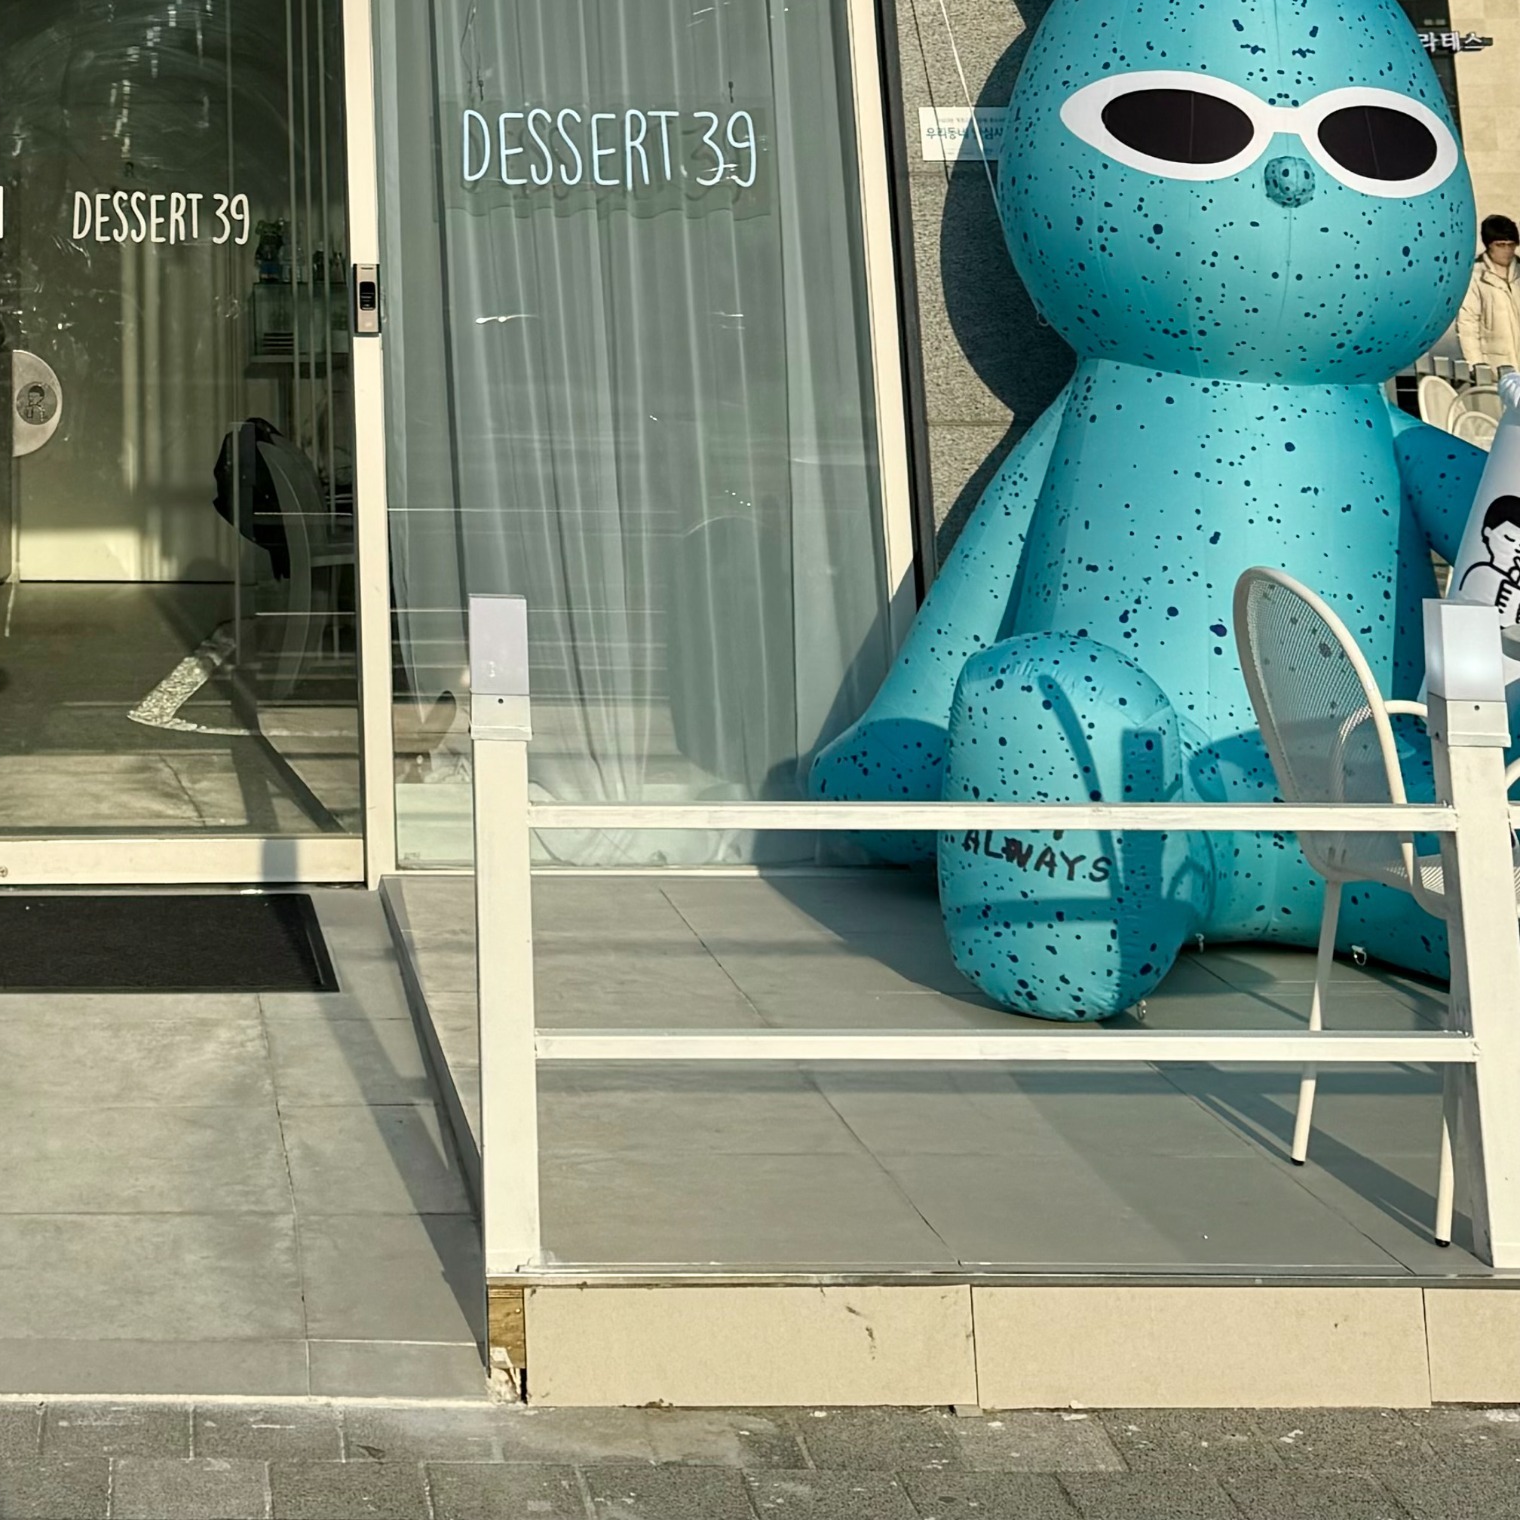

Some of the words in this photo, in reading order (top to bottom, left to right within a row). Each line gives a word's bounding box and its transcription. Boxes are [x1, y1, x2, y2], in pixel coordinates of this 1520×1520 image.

[462, 107, 680, 191] DESSERT
[692, 109, 757, 188] 39
[72, 190, 204, 245] DESSERT
[212, 193, 250, 245] 39
